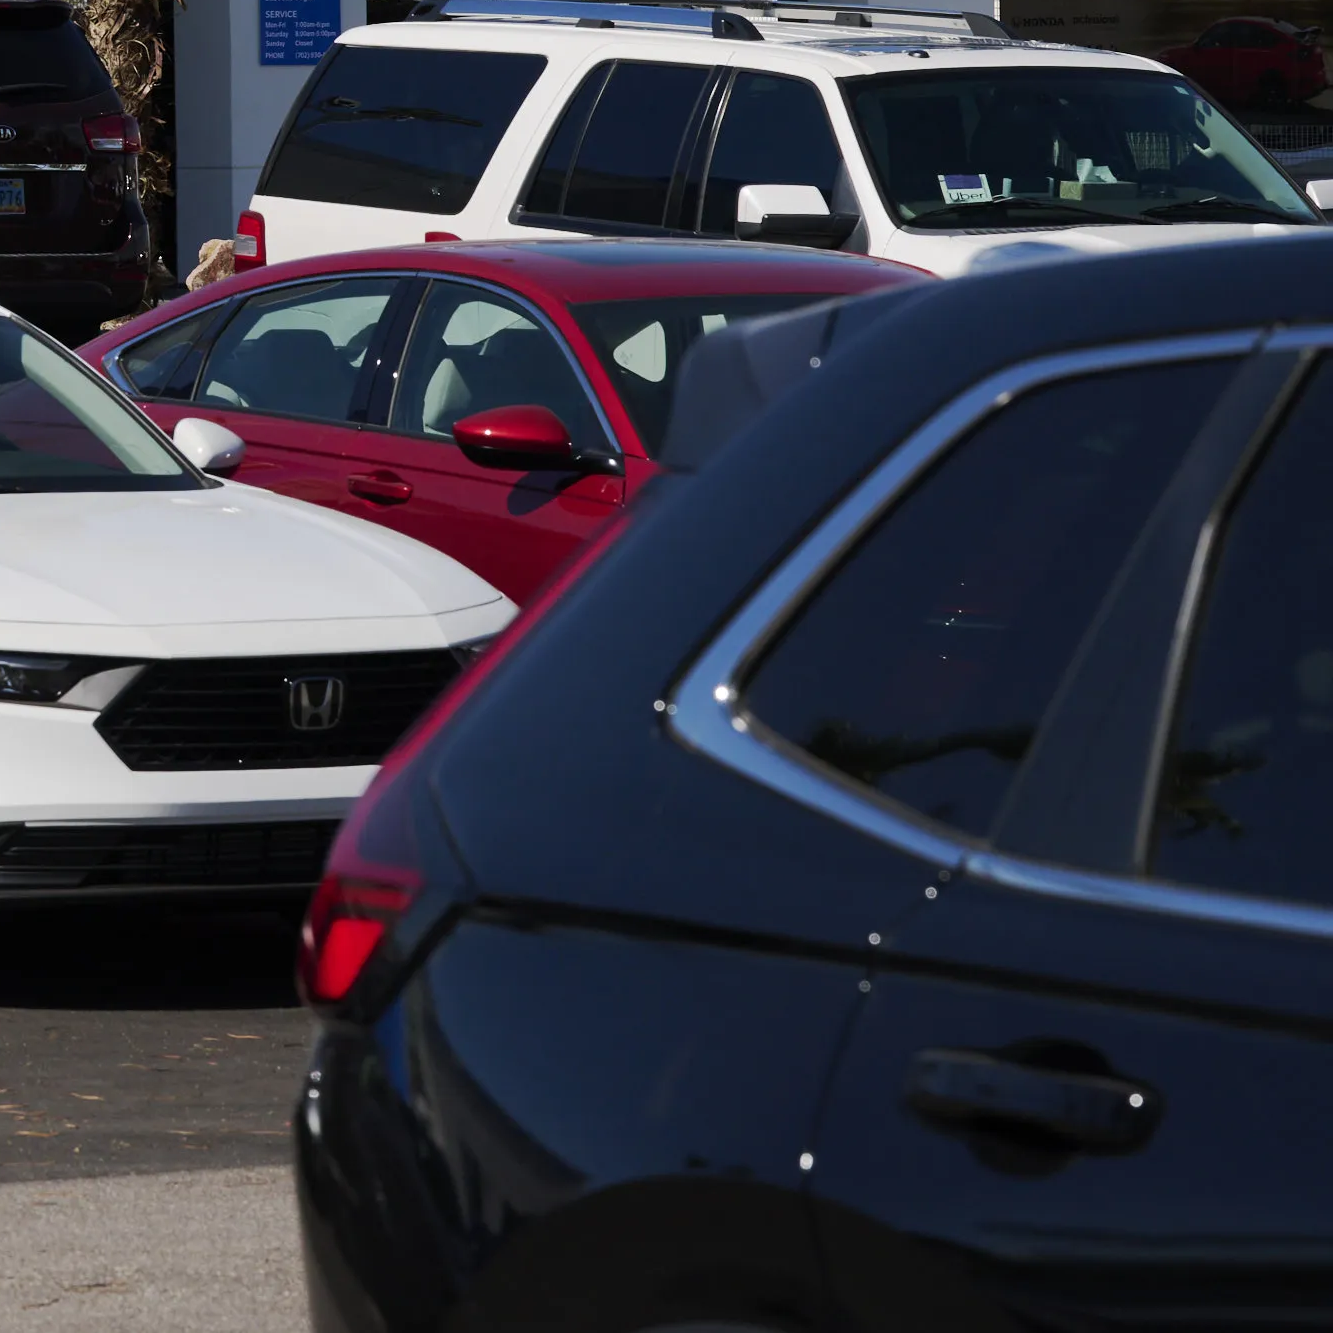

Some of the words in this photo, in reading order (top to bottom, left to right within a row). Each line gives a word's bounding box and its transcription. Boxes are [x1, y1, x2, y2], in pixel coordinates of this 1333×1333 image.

[265, 10, 298, 19] SERVICE
[265, 21, 286, 29] Mon-Fri
[1023, 17, 1065, 27] HONDA
[265, 31, 289, 39] Saturday
[265, 40, 286, 48] Sunday
[295, 39, 313, 47] Closed
[948, 192, 984, 202] Uber
